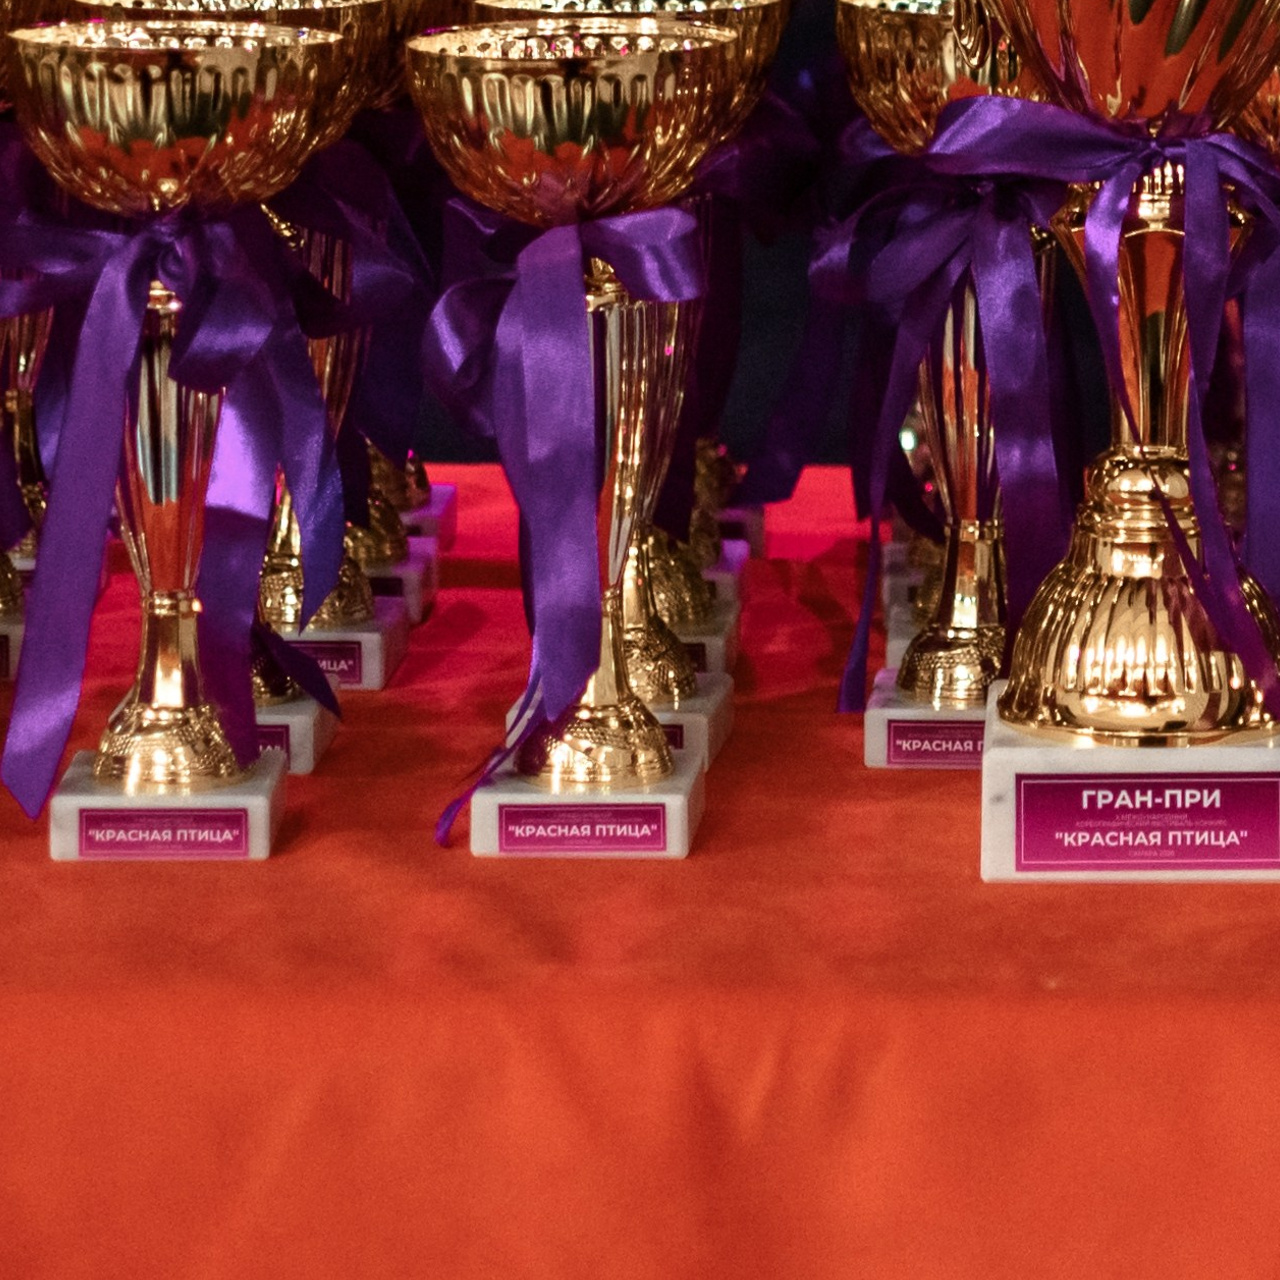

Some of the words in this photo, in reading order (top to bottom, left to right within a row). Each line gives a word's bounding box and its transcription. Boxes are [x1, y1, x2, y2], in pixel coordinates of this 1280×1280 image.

[896, 739, 973, 752] "КРАСНАЯ
[1081, 789, 1222, 810] ГРАН-ПРИ
[89, 829, 172, 842] "КРАСНАЯ
[177, 829, 239, 843] ПТИЦА"
[508, 824, 591, 837] "КРАСНАЯ
[595, 824, 658, 838] ПТИЦА"
[1055, 830, 1162, 847] "КРАСНАЯ
[1168, 830, 1248, 848] ПТИЦА"
